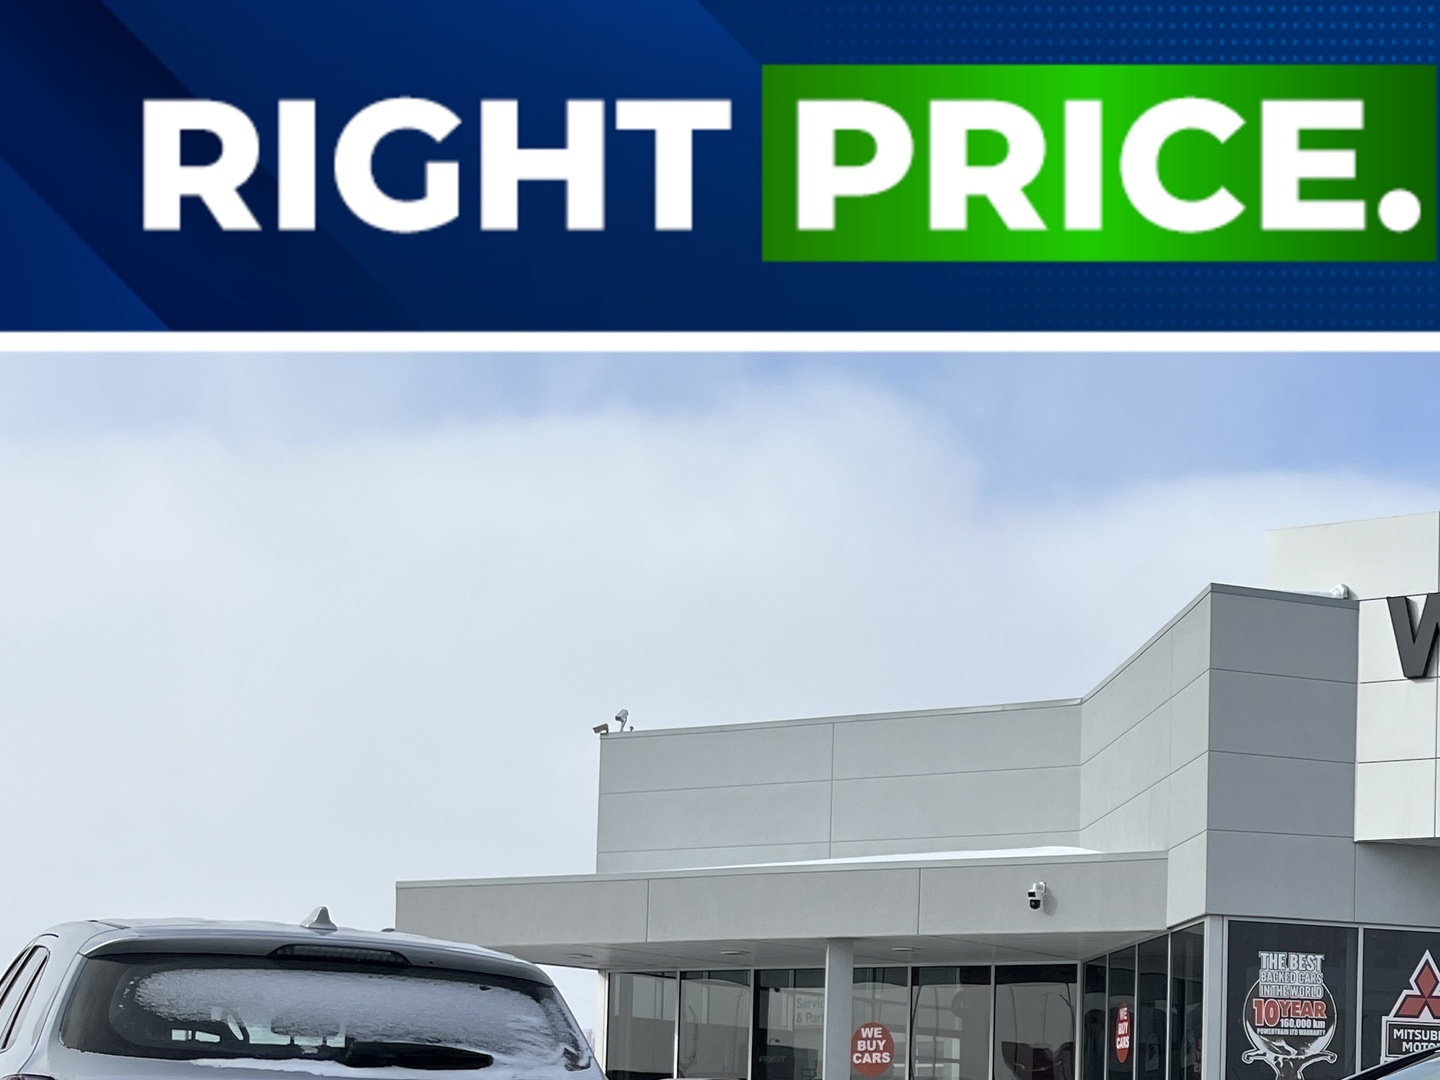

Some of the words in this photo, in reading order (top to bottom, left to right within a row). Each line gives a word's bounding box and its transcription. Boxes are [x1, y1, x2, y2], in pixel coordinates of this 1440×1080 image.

[1259, 952, 1287, 970] THE
[1289, 953, 1324, 972] BEST
[1260, 971, 1297, 983] BACKED
[1299, 971, 1324, 985] CARS
[1261, 984, 1270, 997] IN
[1271, 984, 1289, 997] THE
[1290, 984, 1323, 998] WORLD
[796, 997, 825, 1009] Servic
[806, 1011, 825, 1023] Part
[1253, 998, 1281, 1027] 10
[1280, 999, 1327, 1018] YEAR
[1313, 1019, 1326, 1029] km
[860, 1026, 883, 1039] WE
[857, 1039, 887, 1051] BUY
[1116, 1035, 1130, 1050] CARS
[852, 1052, 891, 1065] CARS
